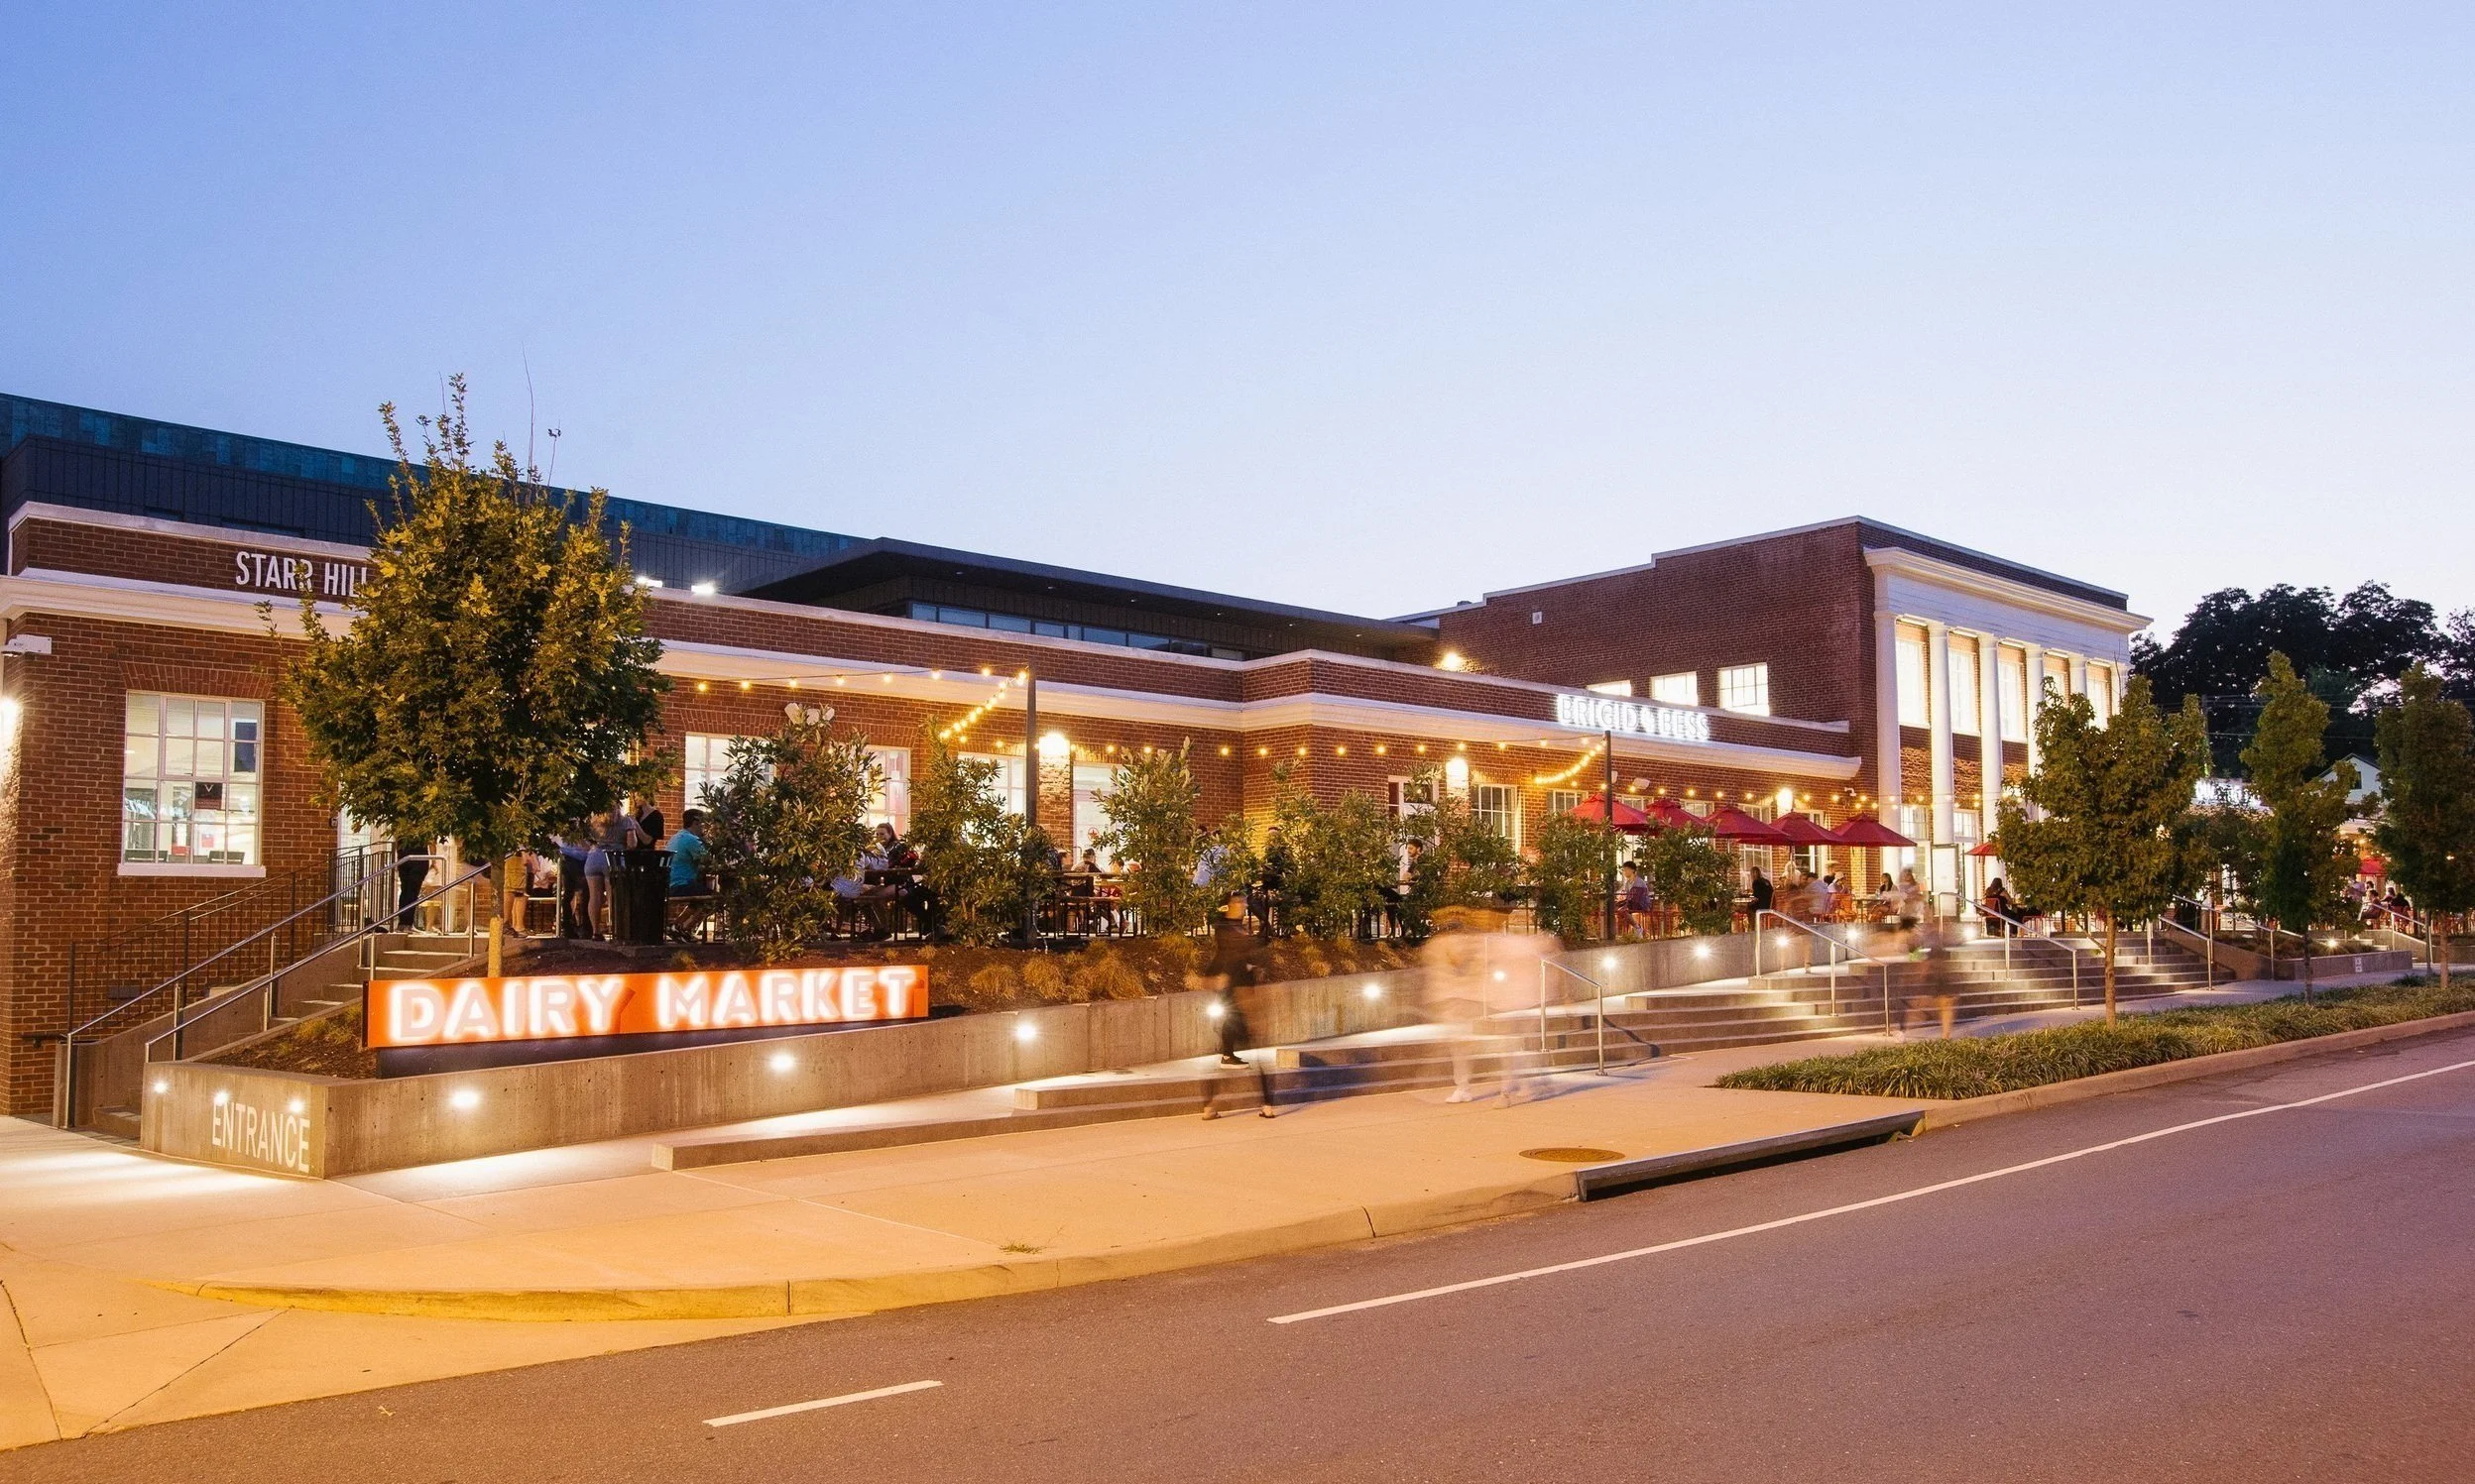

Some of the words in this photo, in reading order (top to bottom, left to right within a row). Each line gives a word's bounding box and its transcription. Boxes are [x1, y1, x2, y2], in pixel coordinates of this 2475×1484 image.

[236, 551, 313, 593] STARR
[1560, 695, 1637, 730] BRIGID
[1661, 709, 1709, 739] BESS
[392, 978, 628, 1040] DAIRY
[658, 970, 915, 1026] MARKET
[212, 1100, 310, 1174] ENTRANCE
